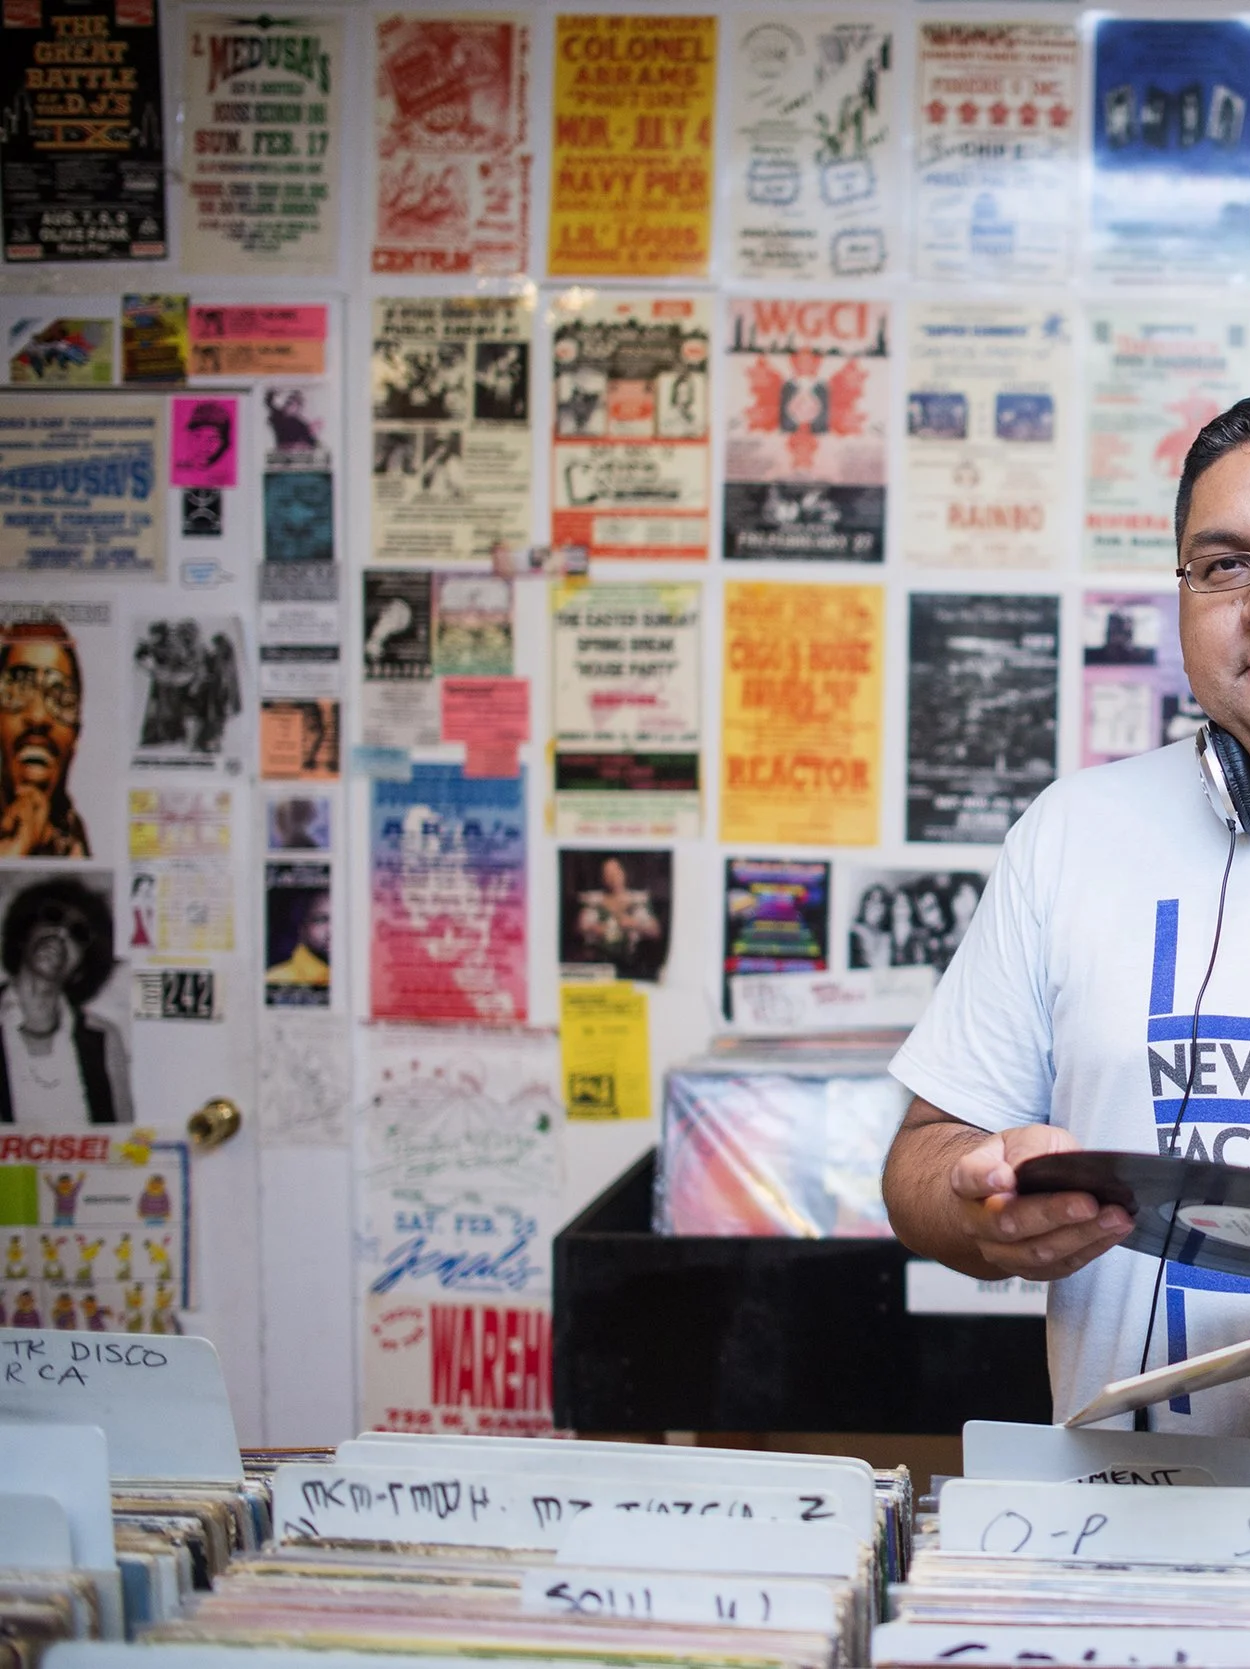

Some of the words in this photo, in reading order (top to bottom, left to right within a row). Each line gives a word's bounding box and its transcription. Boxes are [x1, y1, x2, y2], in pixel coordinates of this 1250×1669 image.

[52, 16, 109, 37] THE
[35, 41, 129, 64] GREAT
[562, 35, 712, 62] COLONEL
[26, 68, 138, 89] BATTLE
[208, 35, 331, 95] MEDUSA'S
[574, 66, 698, 87] ABRAMS
[754, 300, 867, 339] WGCI
[727, 756, 870, 791] REACTOR
[70, 1340, 169, 1368] DISCO
[430, 1303, 554, 1411] WAREH
